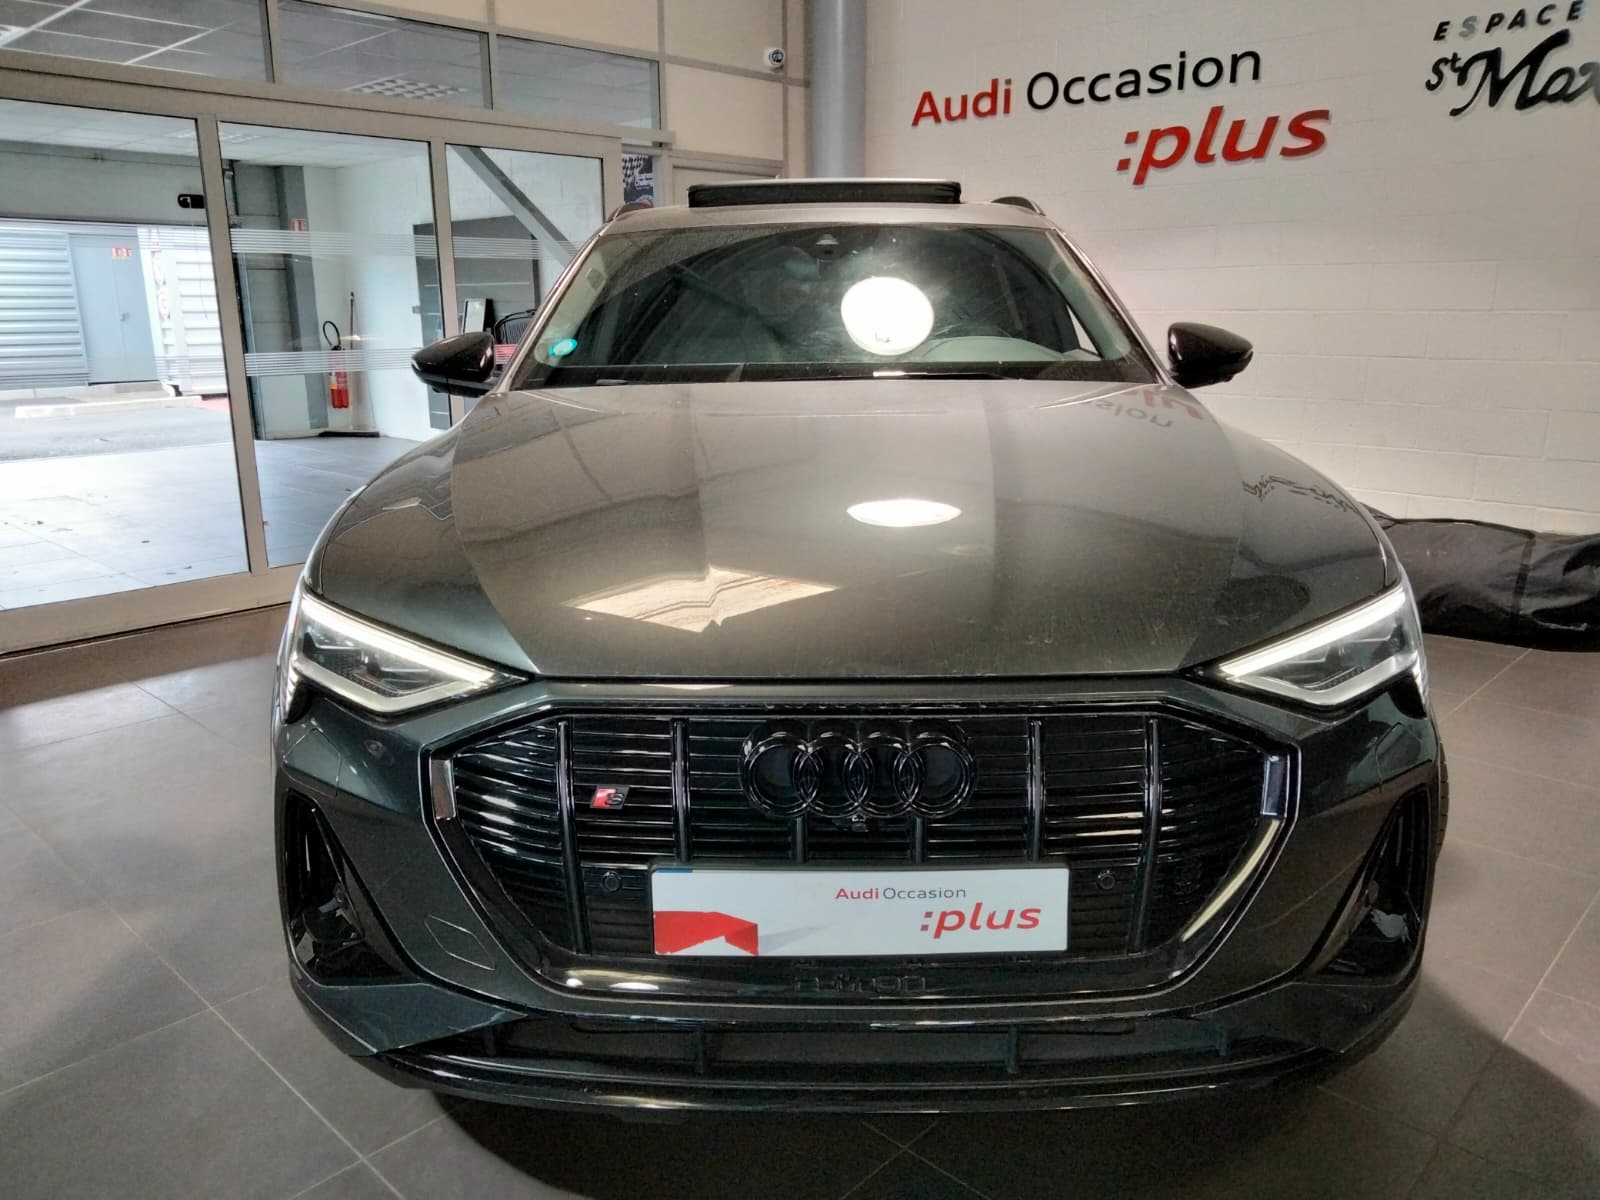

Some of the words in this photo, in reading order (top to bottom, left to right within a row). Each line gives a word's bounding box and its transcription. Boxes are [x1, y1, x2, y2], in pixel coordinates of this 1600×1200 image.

[1434, 0, 1584, 41] ESPACE
[912, 79, 1012, 126] Audi
[1027, 49, 1261, 110] Occasion
[1116, 106, 1330, 185] :plus
[835, 888, 880, 900] Audi
[883, 887, 966, 900] Occasion
[920, 902, 1042, 939] :plus
